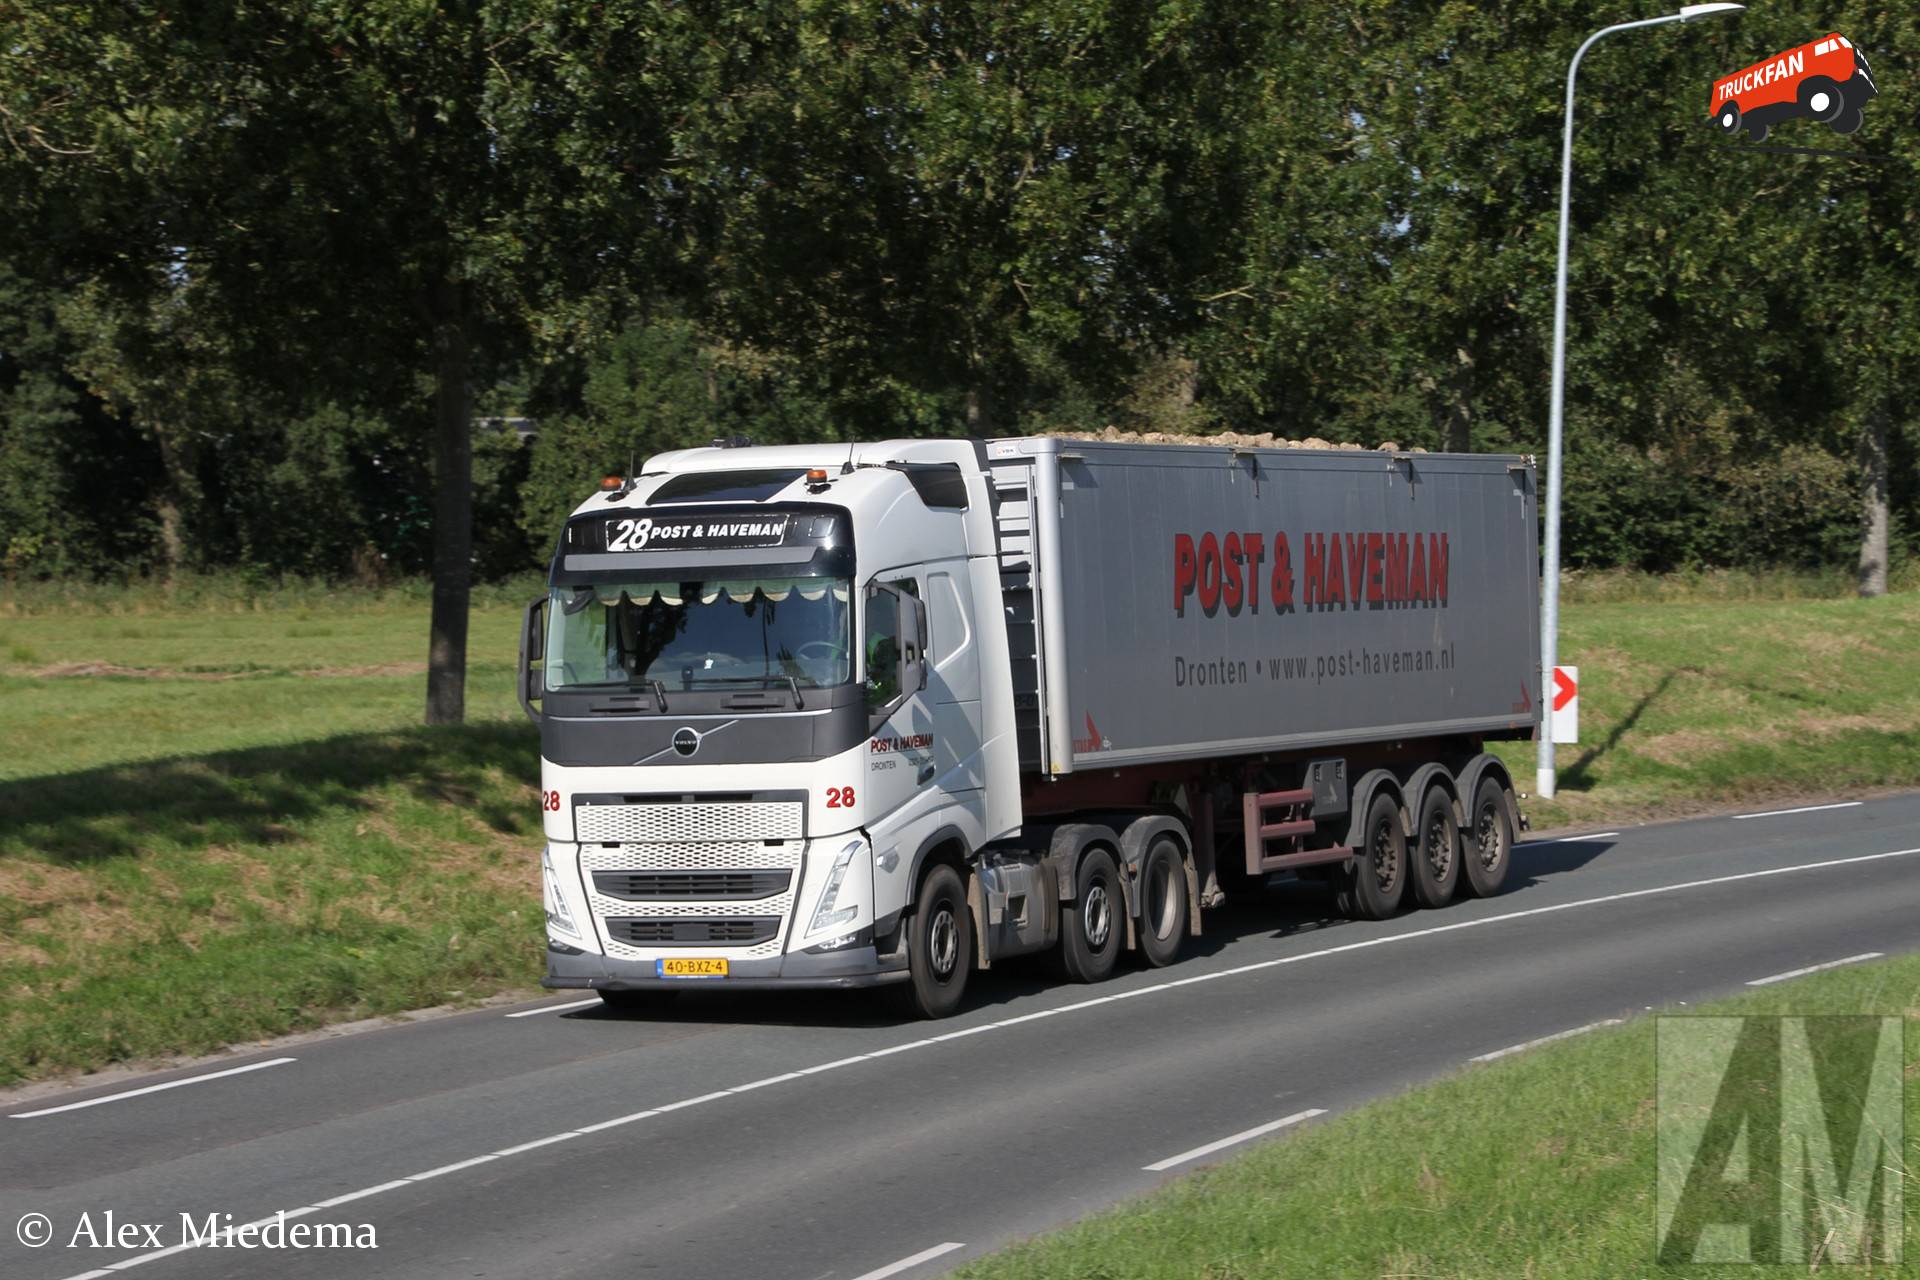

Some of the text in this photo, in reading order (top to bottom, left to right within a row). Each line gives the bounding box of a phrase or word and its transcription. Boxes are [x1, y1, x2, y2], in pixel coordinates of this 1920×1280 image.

[608, 518, 783, 551] 28 POST & HAVEMAN
[1174, 531, 1449, 618] POST & HAVEMAN
[1175, 643, 1455, 687] Dronten www.post-haveman.nl
[871, 737, 891, 752] POST
[900, 733, 934, 750] HAVEMAN
[871, 760, 897, 771] DRONTEN
[543, 790, 560, 811] 28
[826, 786, 855, 808] 28
[666, 961, 723, 973] 40-BXZ-4
